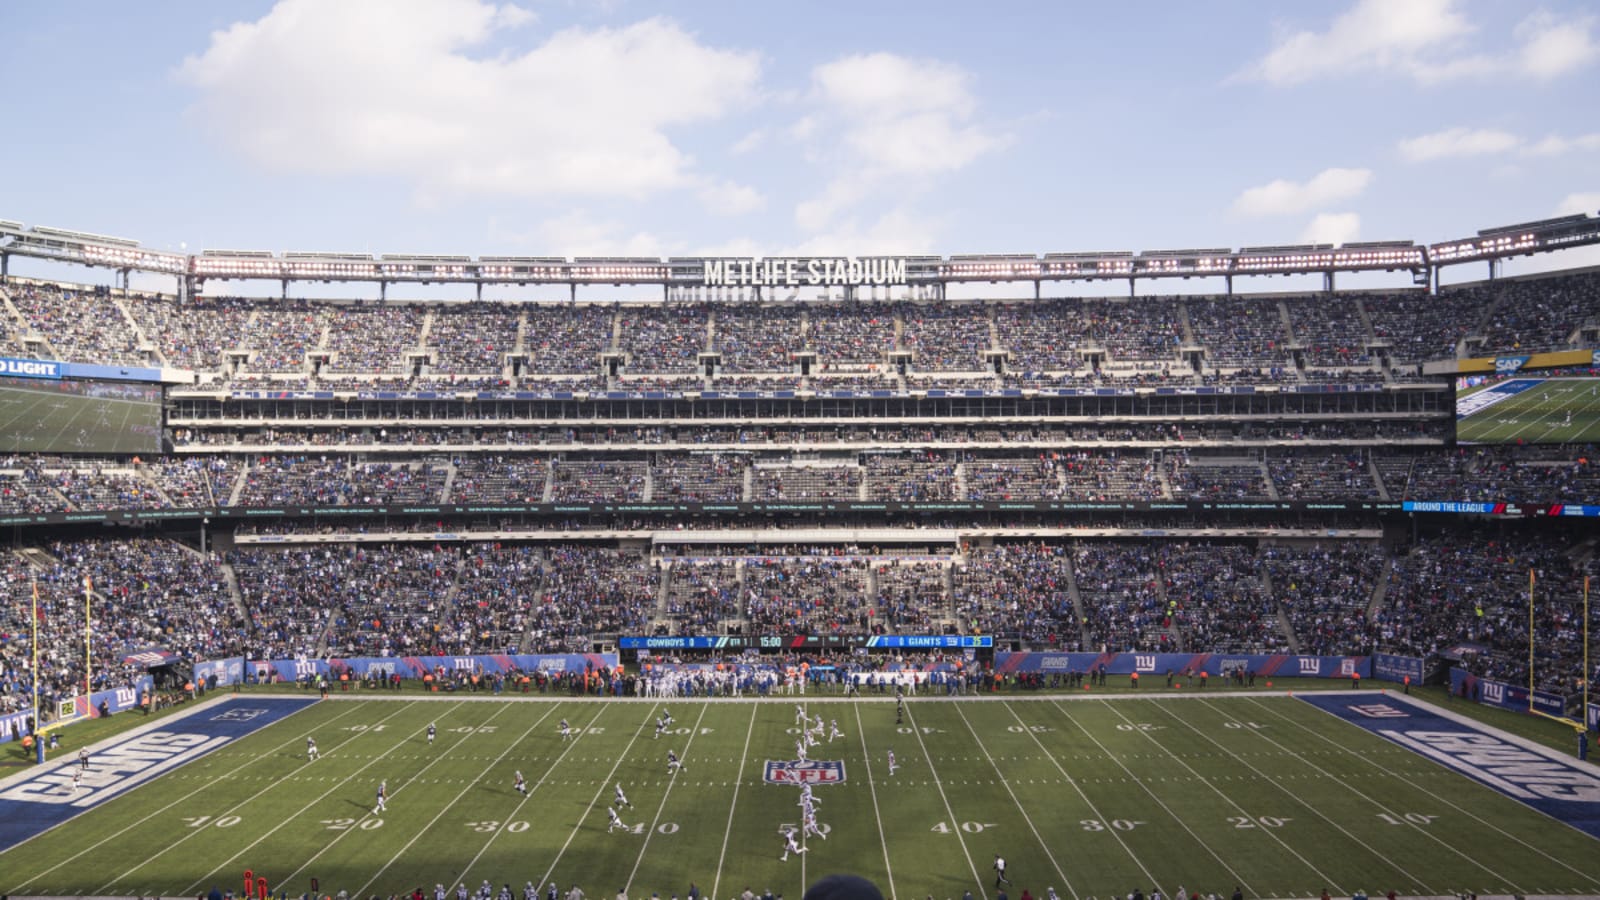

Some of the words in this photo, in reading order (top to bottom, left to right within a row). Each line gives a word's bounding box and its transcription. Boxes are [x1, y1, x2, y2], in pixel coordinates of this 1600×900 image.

[704, 260, 799, 285] METLIFE
[807, 259, 906, 285] STADIUM
[9, 361, 56, 375] LIGHT
[1496, 359, 1521, 372] SAP
[1412, 502, 1440, 511] AROUND
[1443, 502, 1456, 511] THE
[1458, 503, 1485, 512] LEAGUE
[647, 638, 685, 647] COWBOYS
[760, 637, 782, 647] 15:00
[908, 638, 941, 646] GIANTS
[455, 658, 474, 672] ny
[1135, 656, 1155, 671] ny
[1299, 658, 1320, 674] ny
[116, 687, 136, 707] ny
[1483, 683, 1503, 703] ny
[0, 731, 212, 804] GIANTS
[774, 769, 836, 782] NFL
[187, 815, 242, 828] 10
[325, 817, 385, 831] 20
[1226, 816, 1286, 828] 20
[1376, 812, 1432, 825] 10
[474, 820, 531, 833] 30
[628, 822, 680, 834] 40
[930, 821, 985, 834] 40
[1079, 819, 1136, 832] 30
